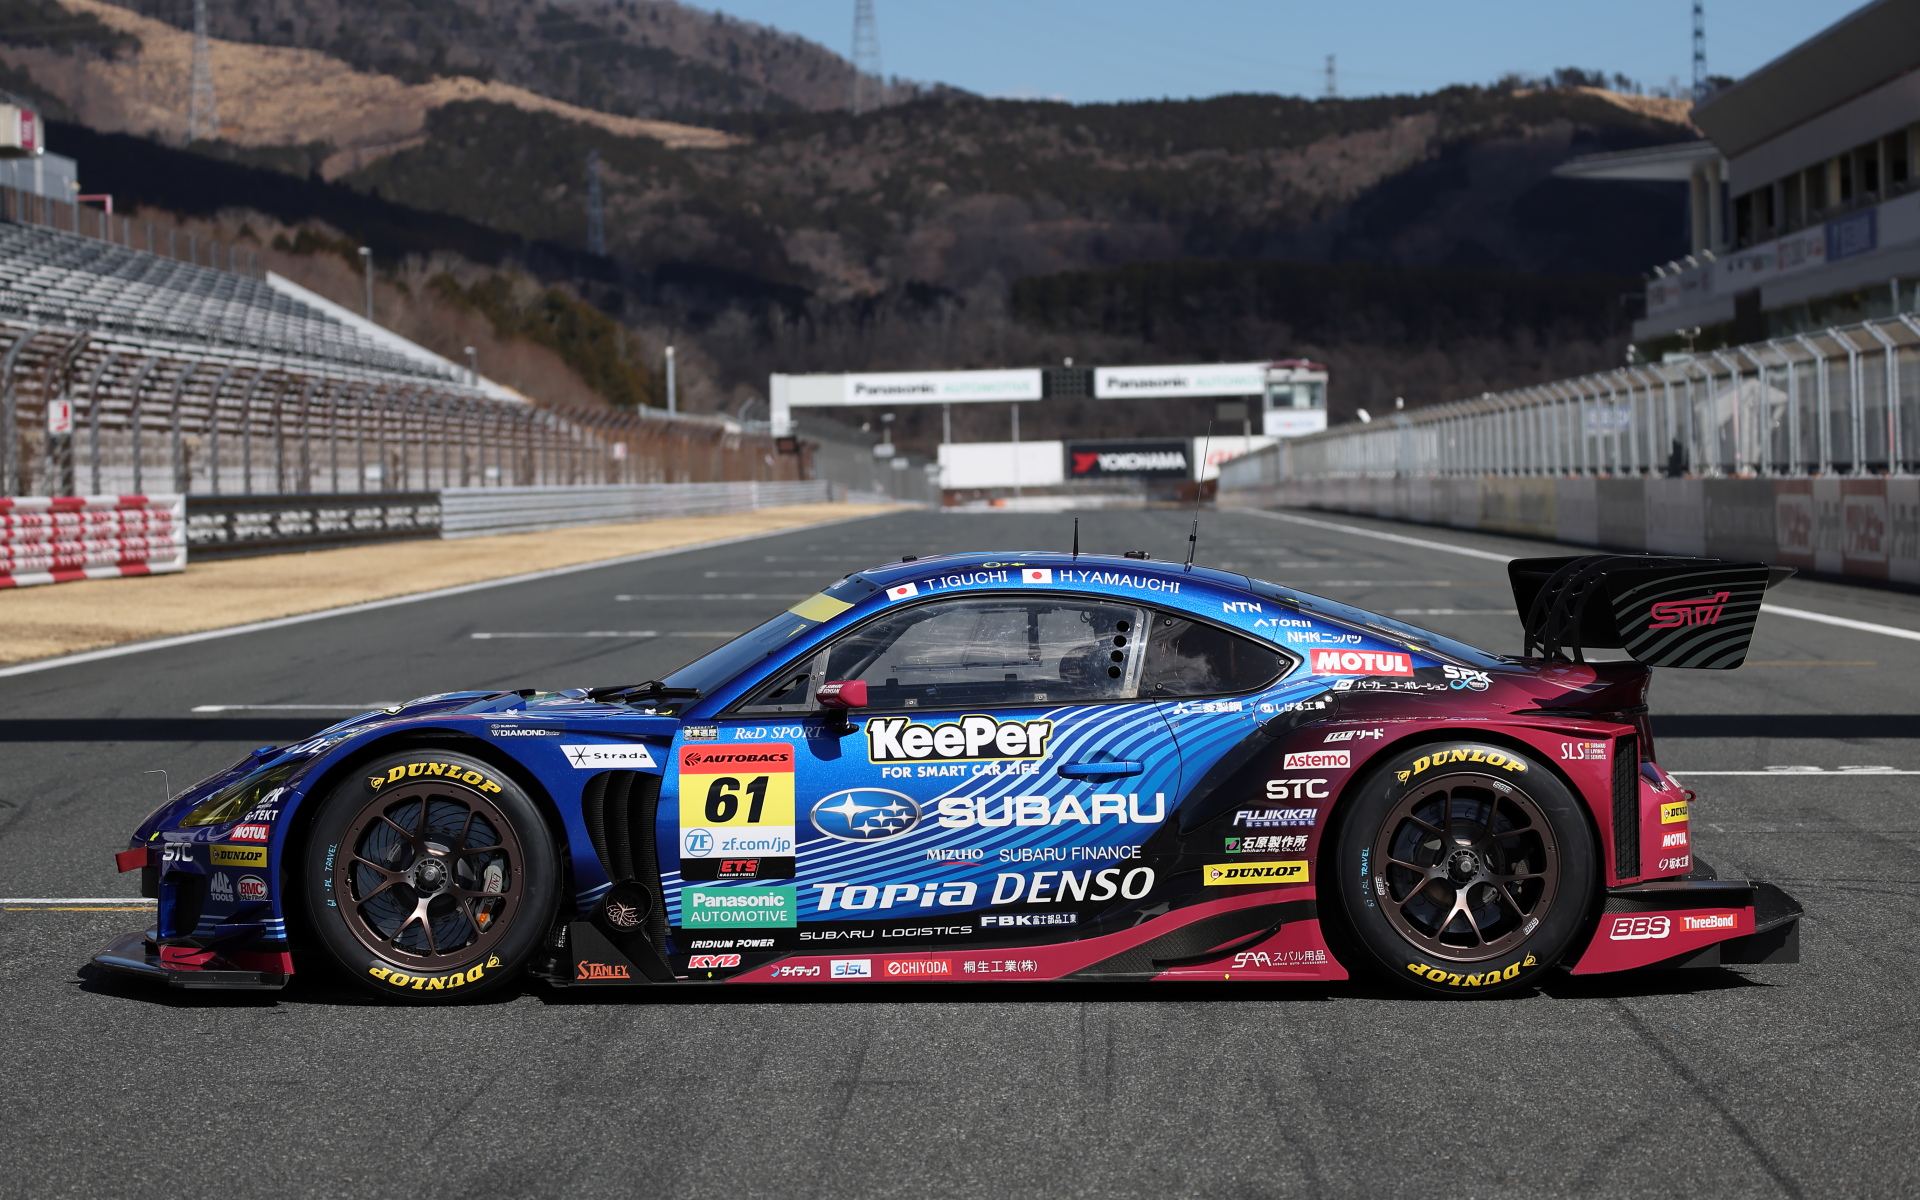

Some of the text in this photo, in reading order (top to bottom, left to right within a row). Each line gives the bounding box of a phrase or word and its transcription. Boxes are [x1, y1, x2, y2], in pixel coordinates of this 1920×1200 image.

[854, 381, 938, 395] Panasonic
[1098, 451, 1187, 472] YOKOHAMA
[922, 570, 1008, 591] T.IGUCHI
[1059, 570, 1180, 594] H.YAMAUCHI
[1222, 602, 1262, 614] NTN
[1316, 652, 1408, 672] MOTUL
[1442, 664, 1494, 683] SPK
[1189, 701, 1242, 714] 三菱製鋼
[1275, 702, 1326, 712] しげる工業
[734, 726, 825, 740] R&D SPORT
[869, 717, 1050, 759] KeePer
[702, 754, 789, 762] AUTOBACS
[1561, 742, 1585, 759] SLS
[1286, 754, 1349, 768] Astemo
[1412, 749, 1526, 776] DUNLOP
[387, 762, 502, 793] DUNLOP
[882, 763, 1040, 778] FOR SMART CAR LIFE
[1266, 778, 1330, 799] STC
[704, 776, 769, 823] 61
[938, 792, 1165, 828] SUBARU
[1232, 808, 1318, 826] FUJIKIKAI
[232, 826, 267, 840] MOTUL
[1662, 832, 1686, 847] MOTUL
[686, 835, 712, 851] ZF
[722, 837, 791, 852] zf.com/jp
[1242, 835, 1308, 848] 石原製作所
[162, 842, 193, 862] STC
[220, 851, 262, 861] DUNLOP
[325, 844, 337, 871] TRAVEL
[926, 848, 984, 860] MIZUHO
[999, 846, 1142, 862] SUBARU FINANCE
[721, 860, 758, 872] ETS
[1361, 847, 1370, 876] TRAVEL
[1225, 867, 1301, 878] DUNLOP
[210, 872, 233, 893] MAC
[240, 882, 264, 895] BMC
[990, 866, 1155, 905] DENSO
[211, 893, 234, 902] TOOLS
[692, 892, 785, 907] Panasonic
[690, 910, 788, 922] AUTOMOTIVE
[981, 915, 1032, 927] FBK
[1684, 914, 1734, 929] ThreeBond
[800, 926, 972, 940] SUBARU LOGISTICS
[1610, 916, 1671, 940] BBS
[691, 939, 774, 948] IRIDIUM POWER
[688, 954, 741, 969] KYB
[1273, 950, 1326, 961] スバル用品
[576, 960, 631, 979] STANLEY
[781, 966, 820, 976] ダイテック
[901, 961, 948, 974] CHIYODA
[963, 960, 1038, 973] 桐生工業(株)
[1407, 961, 1521, 987] DUNLOP
[369, 963, 484, 990] DUNLOP
